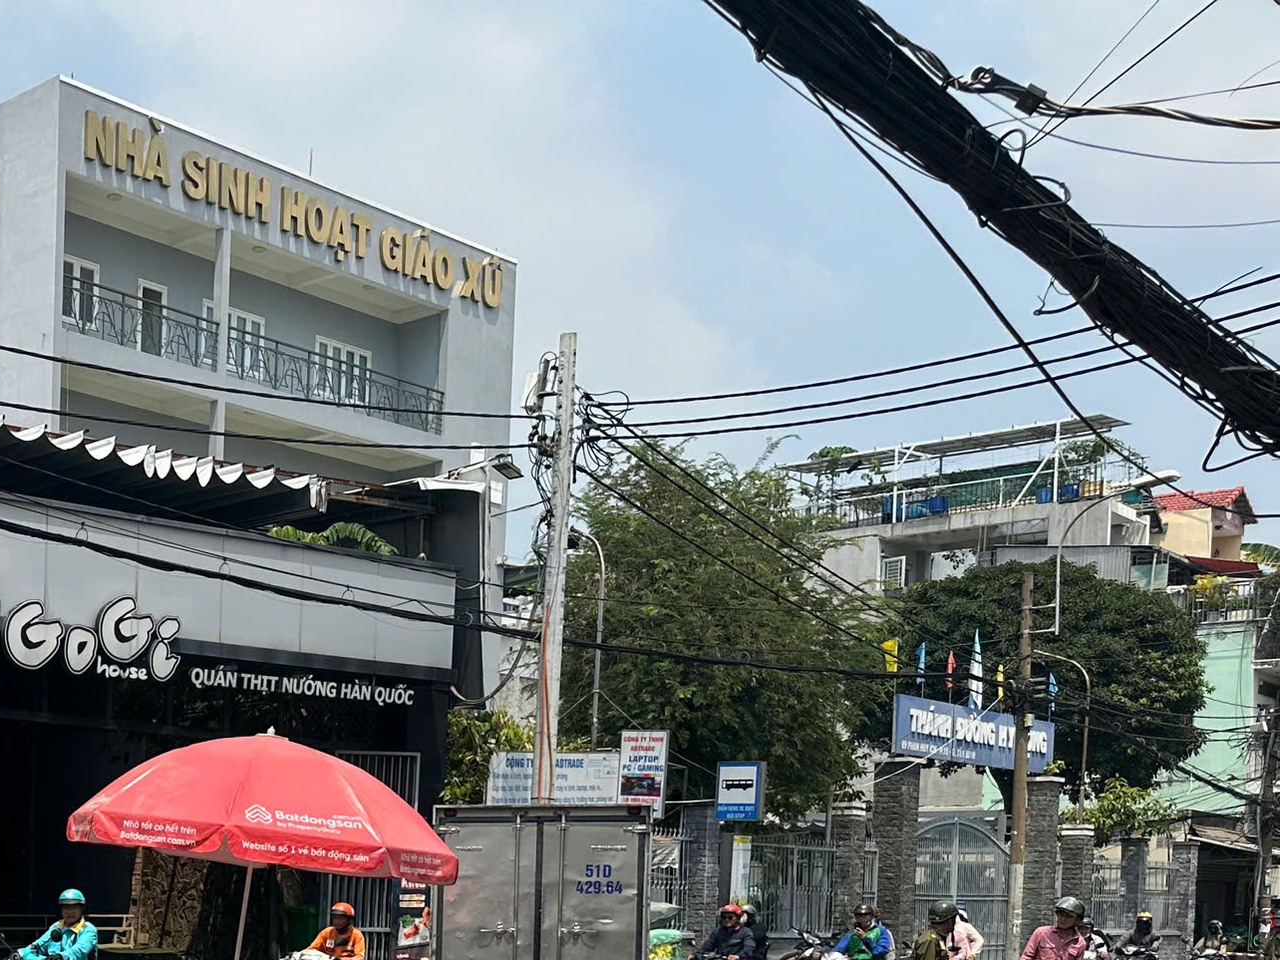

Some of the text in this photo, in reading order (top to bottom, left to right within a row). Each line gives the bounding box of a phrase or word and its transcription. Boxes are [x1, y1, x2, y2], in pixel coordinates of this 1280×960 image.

[84, 110, 171, 187] NHÀ
[181, 151, 269, 224] SINH
[280, 186, 371, 262] HOẠT
[380, 226, 455, 290] GIÁO
[5, 595, 181, 681] GoGi
[97, 655, 148, 681] house
[191, 666, 414, 706] QUÁN THỊT NƯỚNG HÀN QUỐC
[909, 705, 953, 739] THÁNH
[998, 725, 1016, 749] HY
[629, 755, 659, 763] LAPTOP
[141, 819, 152, 830] tốt
[165, 821, 179, 833] hết
[180, 825, 197, 835] trên
[275, 810, 362, 829] Batdongsan
[120, 831, 196, 846] Batdongsan.com.vn
[242, 840, 369, 862] Website số 1 về bất động sản
[585, 864, 612, 878] 51D
[576, 880, 623, 895] 429.64
